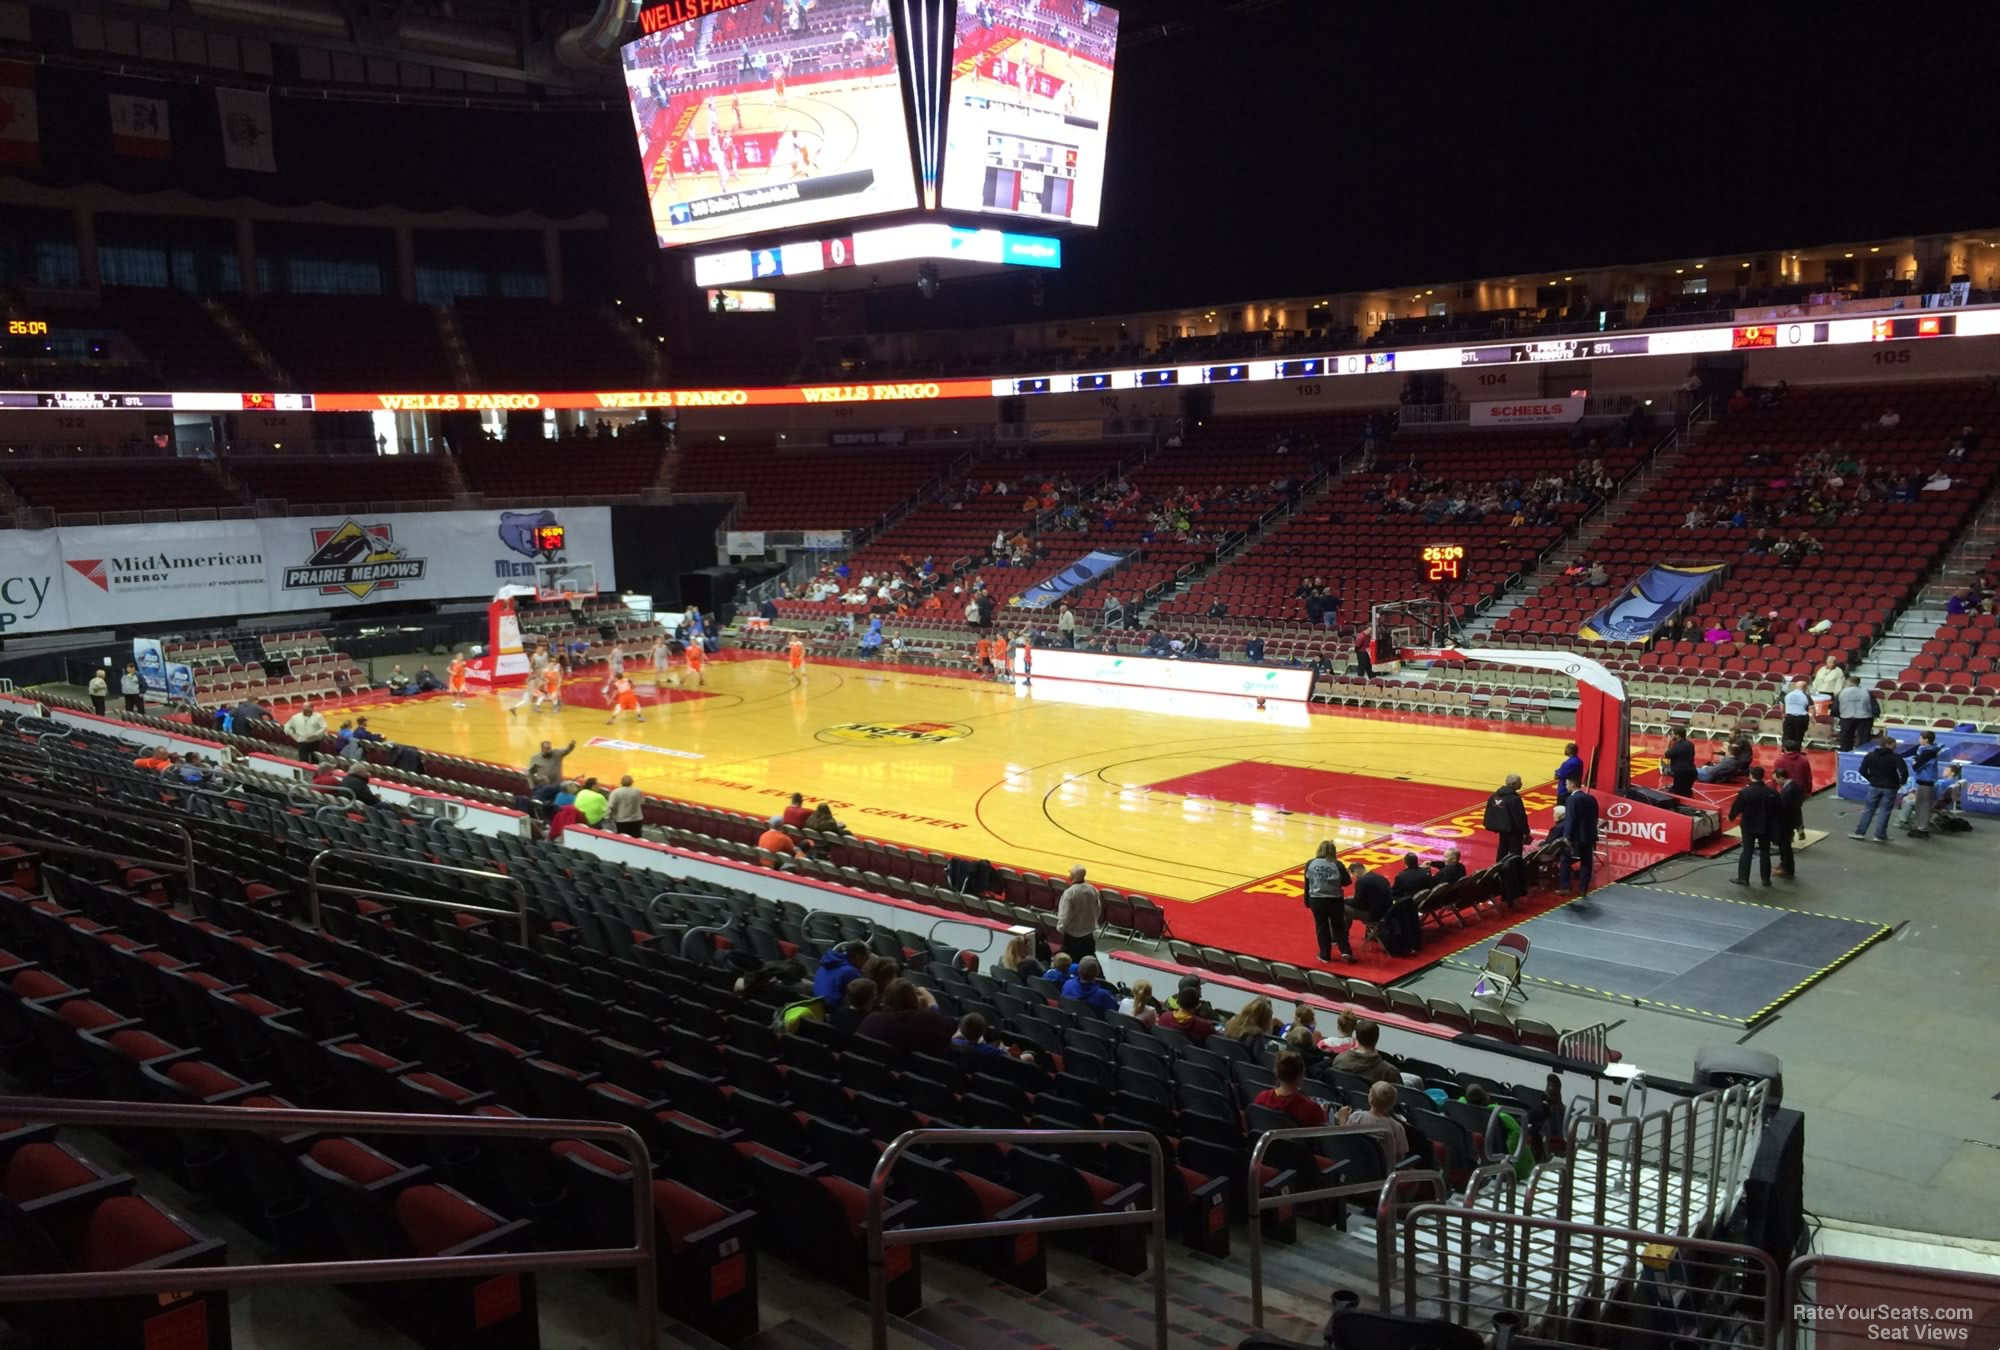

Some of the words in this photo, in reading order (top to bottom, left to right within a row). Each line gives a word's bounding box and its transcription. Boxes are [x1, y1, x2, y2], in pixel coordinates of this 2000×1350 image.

[640, 0, 697, 33] WELLS
[9, 321, 47, 334] 26:09
[1594, 343, 1614, 354] STL
[1461, 352, 1479, 361] STL
[1872, 351, 1910, 364] 105
[1478, 374, 1507, 385] 104
[801, 387, 869, 403] WELLS
[873, 384, 939, 400] FARGO
[1296, 384, 1321, 396] 103
[125, 397, 143, 406] STL
[378, 394, 459, 410] WELLS
[464, 393, 540, 409] FARGO
[596, 392, 672, 407] WELLS
[676, 391, 748, 406] FARGO
[1490, 404, 1562, 417] SCHEELS
[56, 417, 85, 428] 122
[263, 417, 287, 427] 124
[544, 536, 561, 549] 24
[1423, 546, 1463, 560] 26:09
[112, 552, 263, 573] MidAmerican
[289, 568, 346, 585] PRAIRIE
[351, 563, 420, 581] MEADOWS
[1430, 560, 1457, 580] 24
[114, 573, 169, 584] ENERGY
[695, 777, 753, 791] IOWA
[859, 807, 969, 831] CENTER
